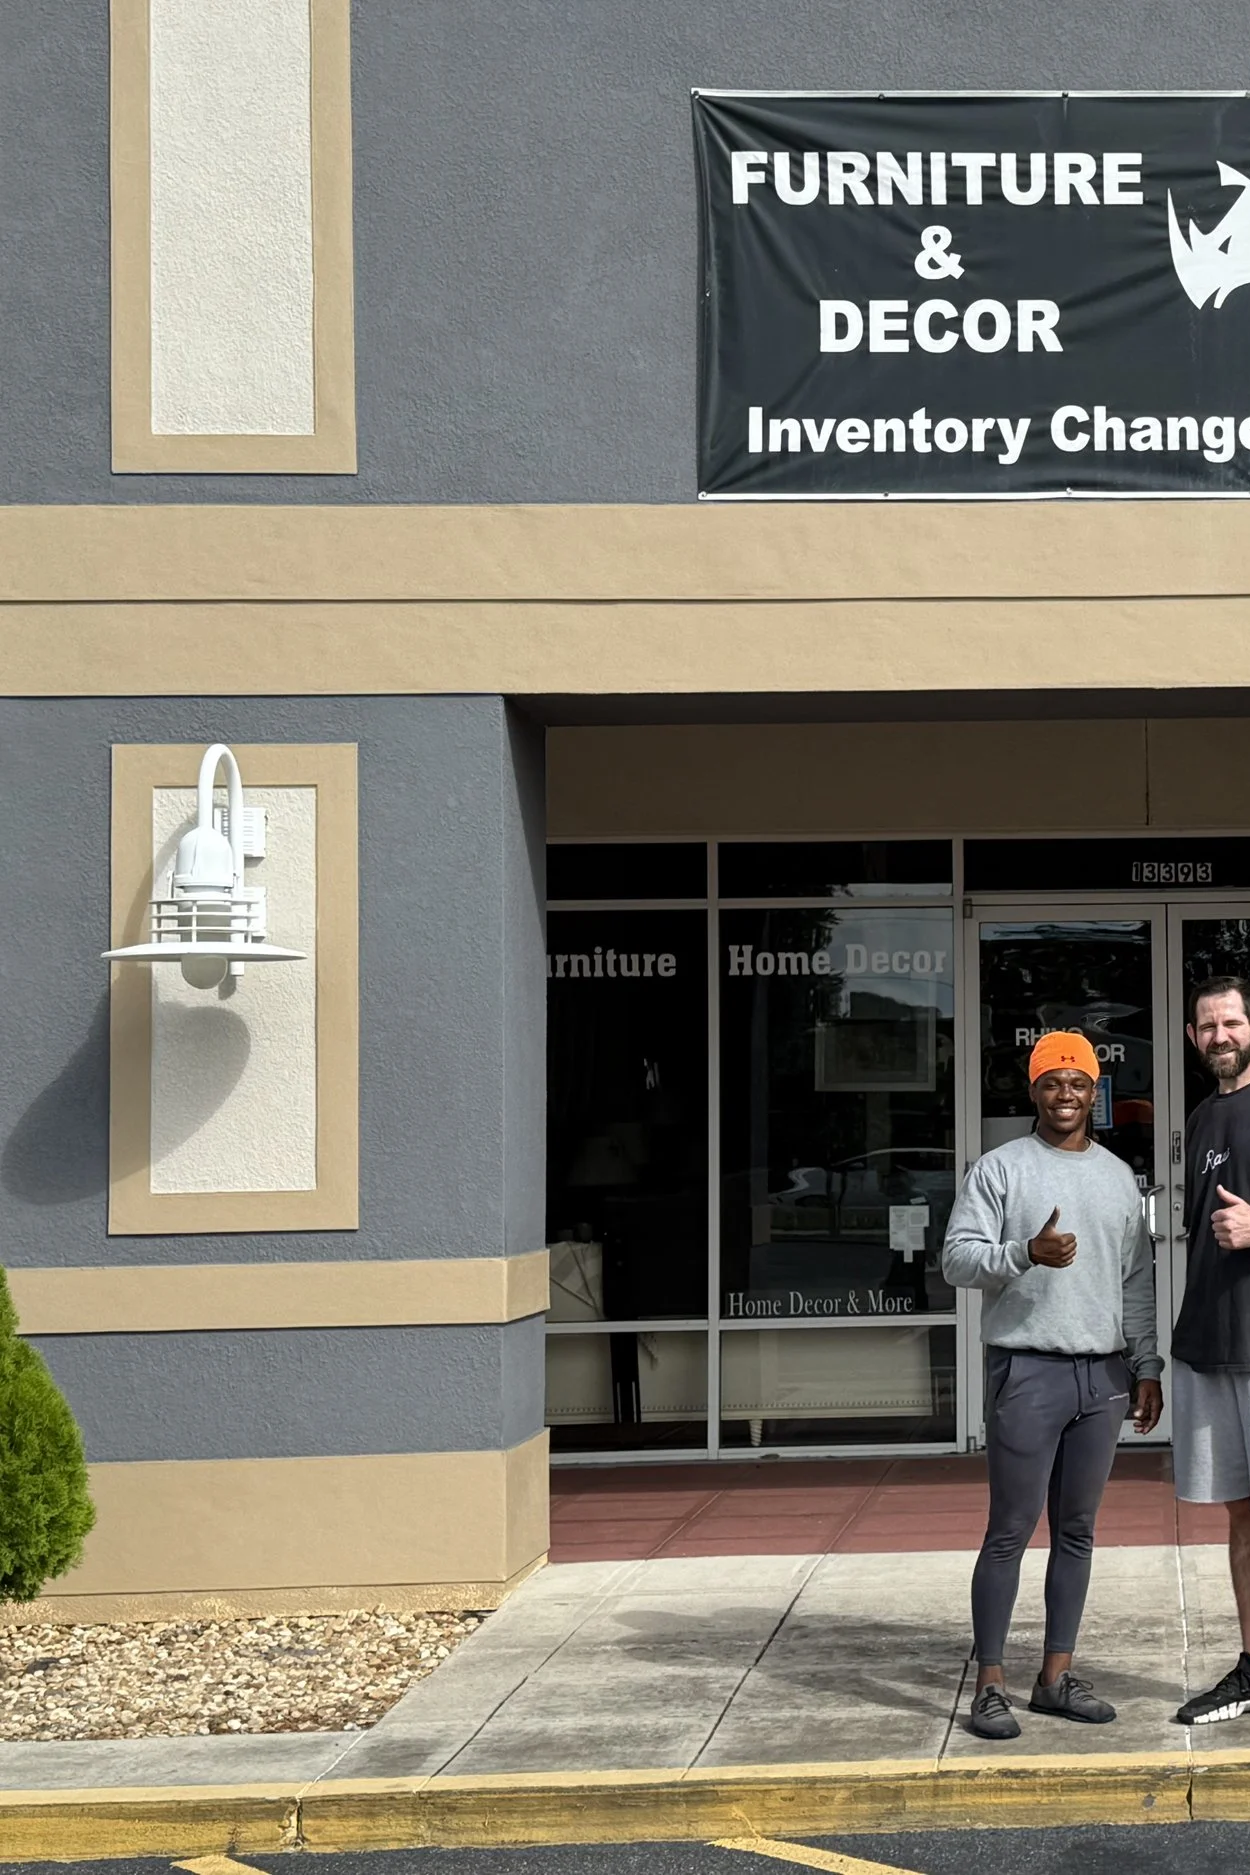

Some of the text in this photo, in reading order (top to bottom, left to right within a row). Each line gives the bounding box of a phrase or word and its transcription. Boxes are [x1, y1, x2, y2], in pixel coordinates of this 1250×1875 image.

[730, 150, 1144, 206] FURNITURE
[914, 225, 965, 280] &
[819, 298, 1064, 354] DECOR
[748, 406, 1032, 465] Inventory
[1132, 861, 1212, 882] 13393
[728, 943, 947, 976] Home Decor
[728, 1288, 913, 1317] Home Decor & More
